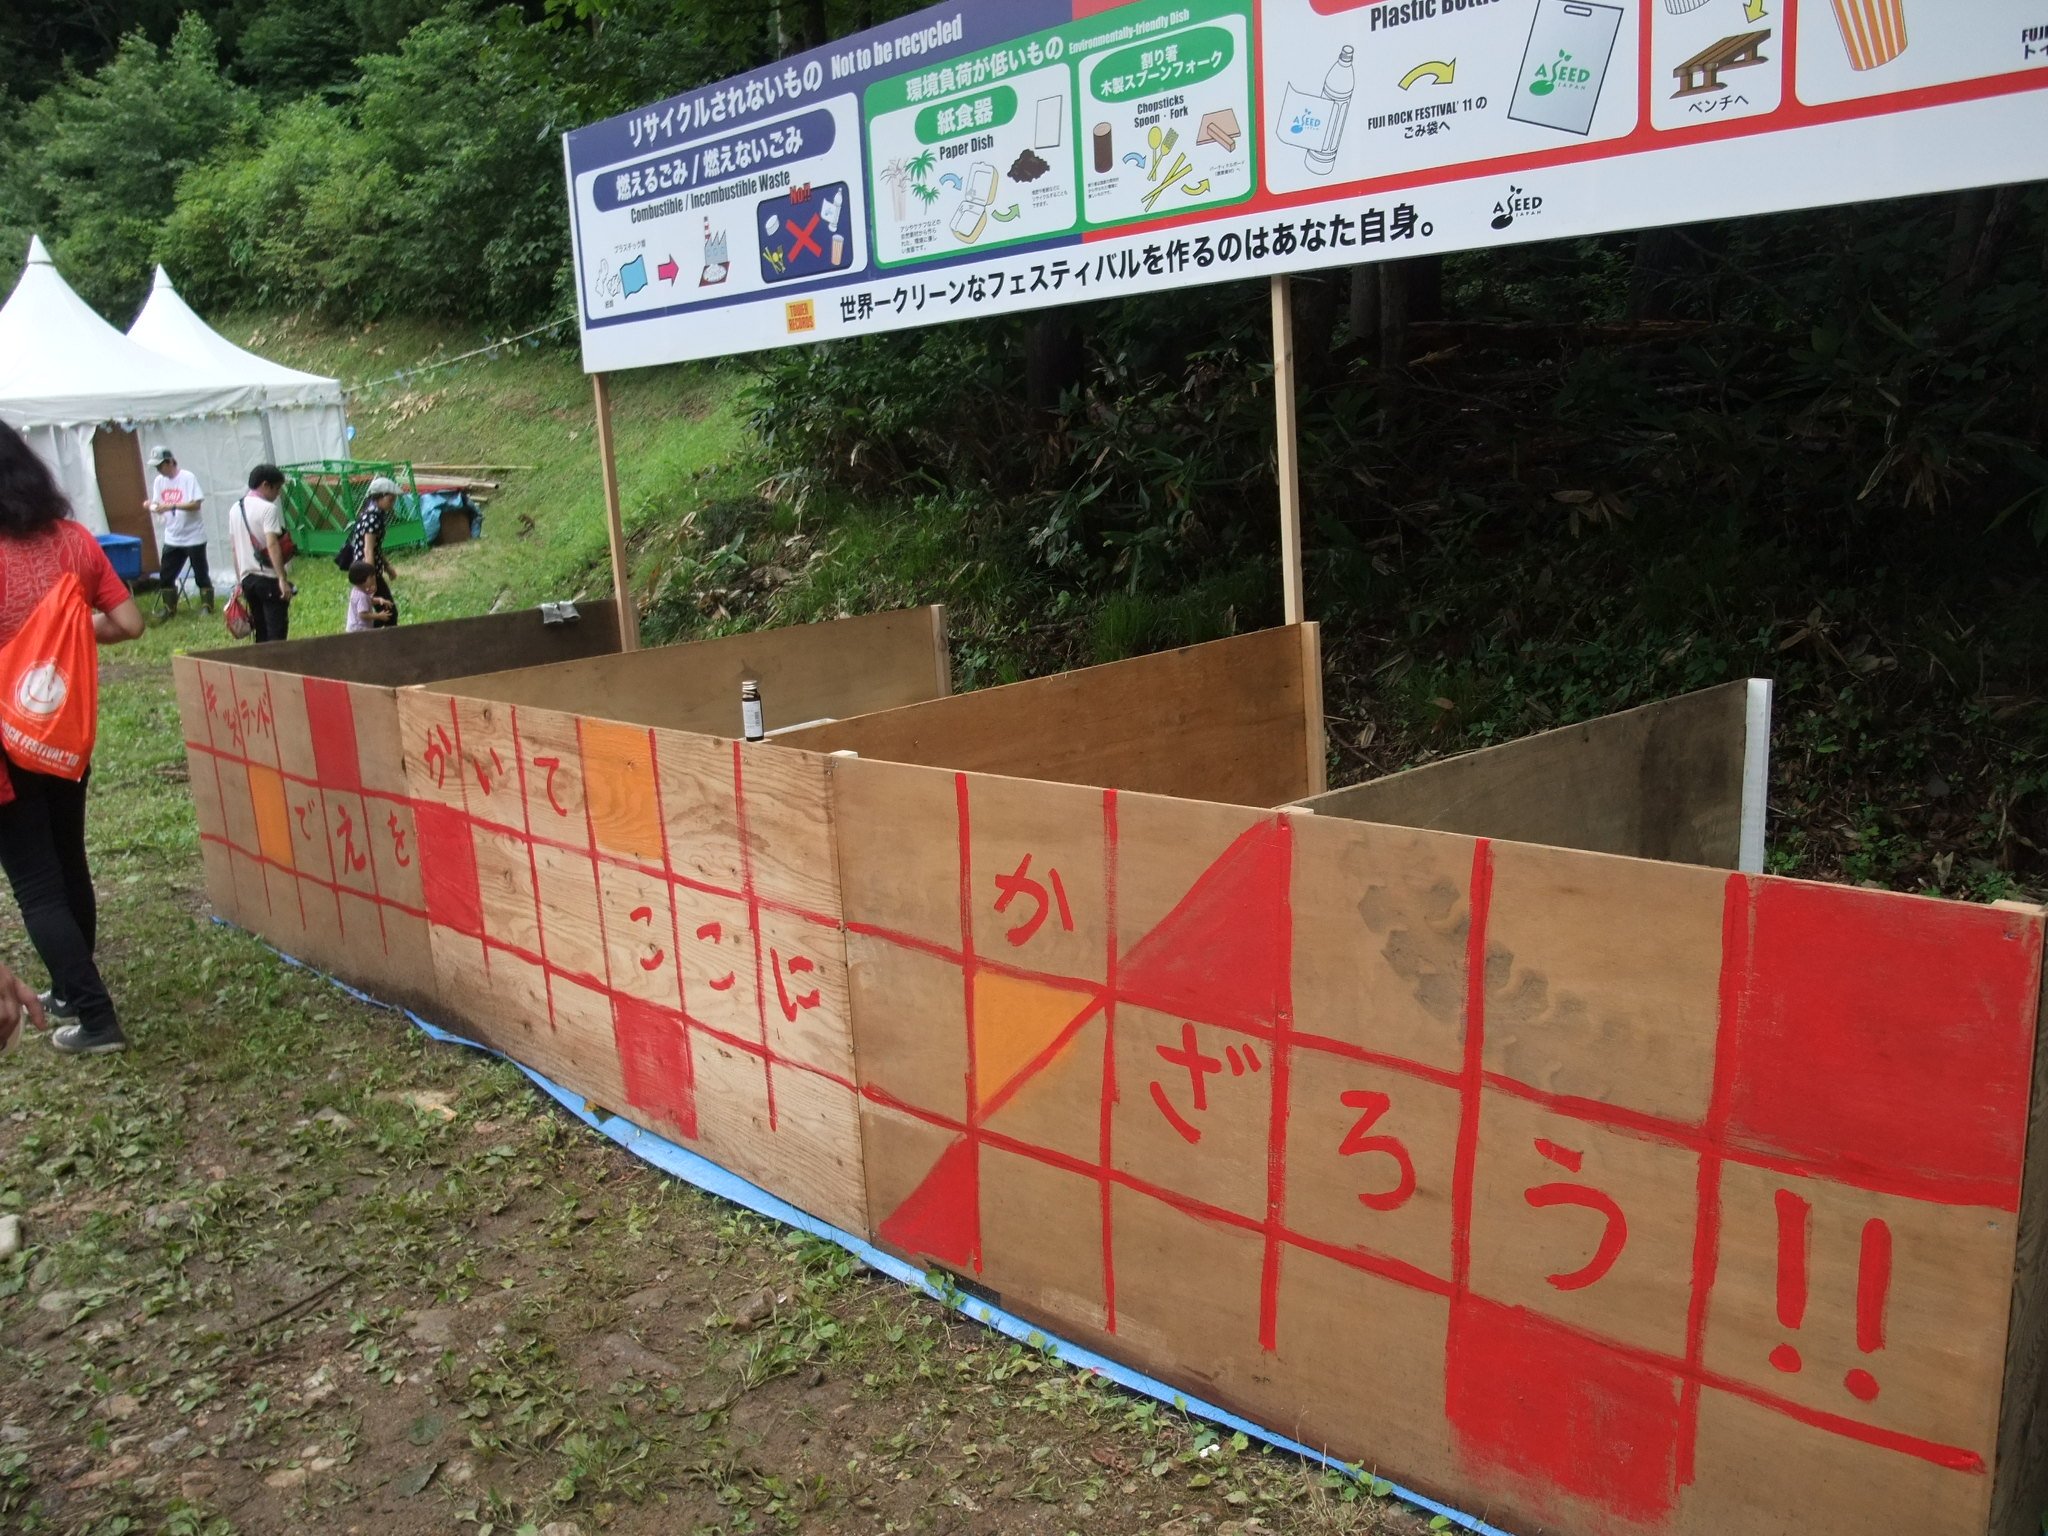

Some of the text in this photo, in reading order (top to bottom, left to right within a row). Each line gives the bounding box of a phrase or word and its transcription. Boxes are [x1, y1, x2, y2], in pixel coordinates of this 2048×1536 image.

[1371, 0, 1436, 31] Plastic
[906, 8, 1190, 102] 環境負荷が低いもの Environmentally-friendly Dish
[1100, 50, 1223, 96] 木製スプーンフォーク
[1141, 44, 1178, 70] 割り箸
[629, 13, 963, 147] リサイクルされないもの Not to be recycled
[936, 97, 993, 135] 紙食器
[1134, 112, 1160, 128] Spoon
[1170, 105, 1189, 120] Fork
[1138, 94, 1184, 115] Chopsticks
[1368, 117, 1387, 130] FUJI
[1388, 110, 1413, 126] ROCK
[1475, 96, 1488, 109] の
[1688, 95, 1749, 113] ベンチへ
[940, 134, 994, 161] Paper Dish
[1404, 121, 1450, 139] ごみ袋へ
[616, 159, 688, 201] 燃えるごみ
[703, 126, 803, 177] 燃えないごみ
[631, 201, 683, 224] Combustible
[691, 177, 757, 208] Incombustible
[759, 170, 790, 191] Waste
[840, 203, 1434, 324] 世界一クリーンなフェスティバルを作るのはあなた自身。
[424, 724, 567, 817] かいて
[294, 799, 410, 875] でえを
[630, 907, 821, 1022] ここに
